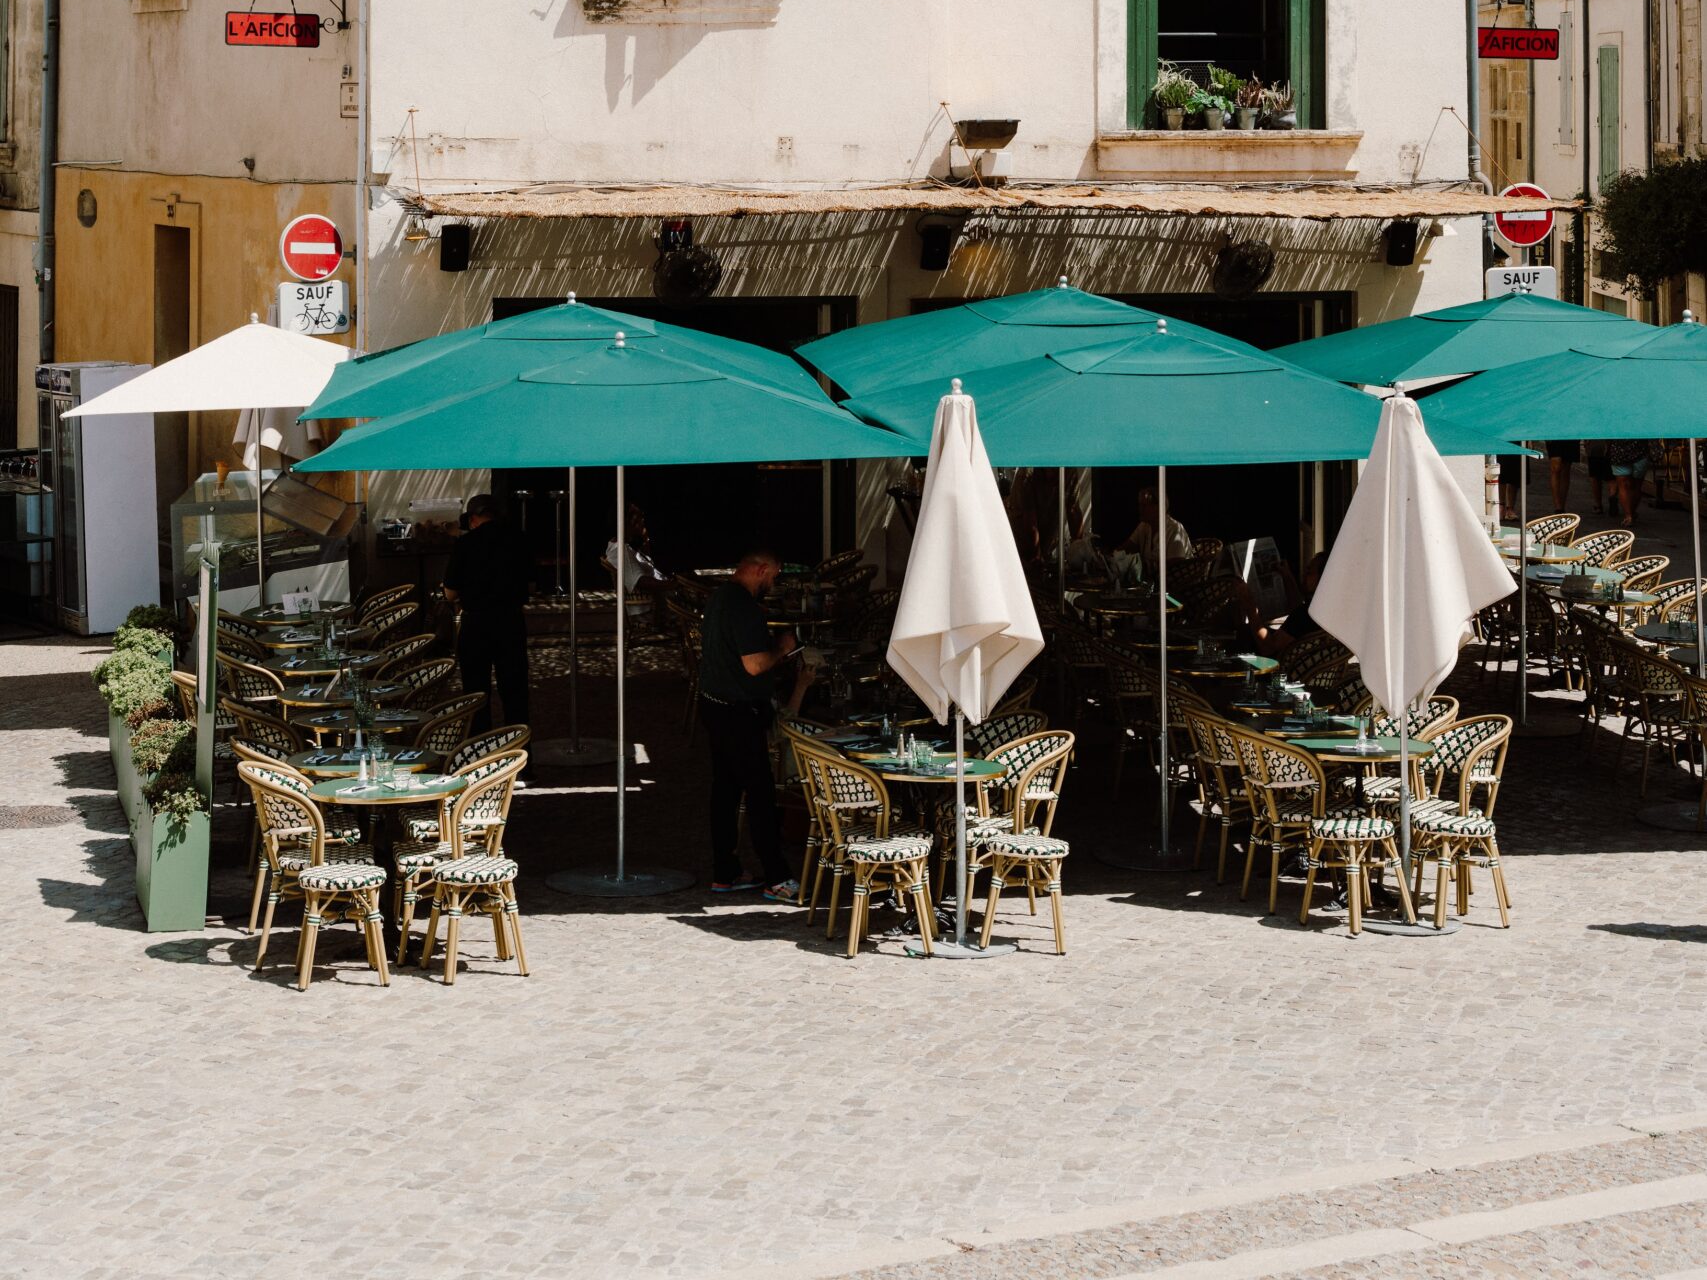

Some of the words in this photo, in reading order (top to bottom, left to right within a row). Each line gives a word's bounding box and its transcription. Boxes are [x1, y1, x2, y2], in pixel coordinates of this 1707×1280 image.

[228, 21, 316, 38] L'AFICION
[1503, 272, 1540, 285] SAUF
[297, 286, 333, 300] SAUF
